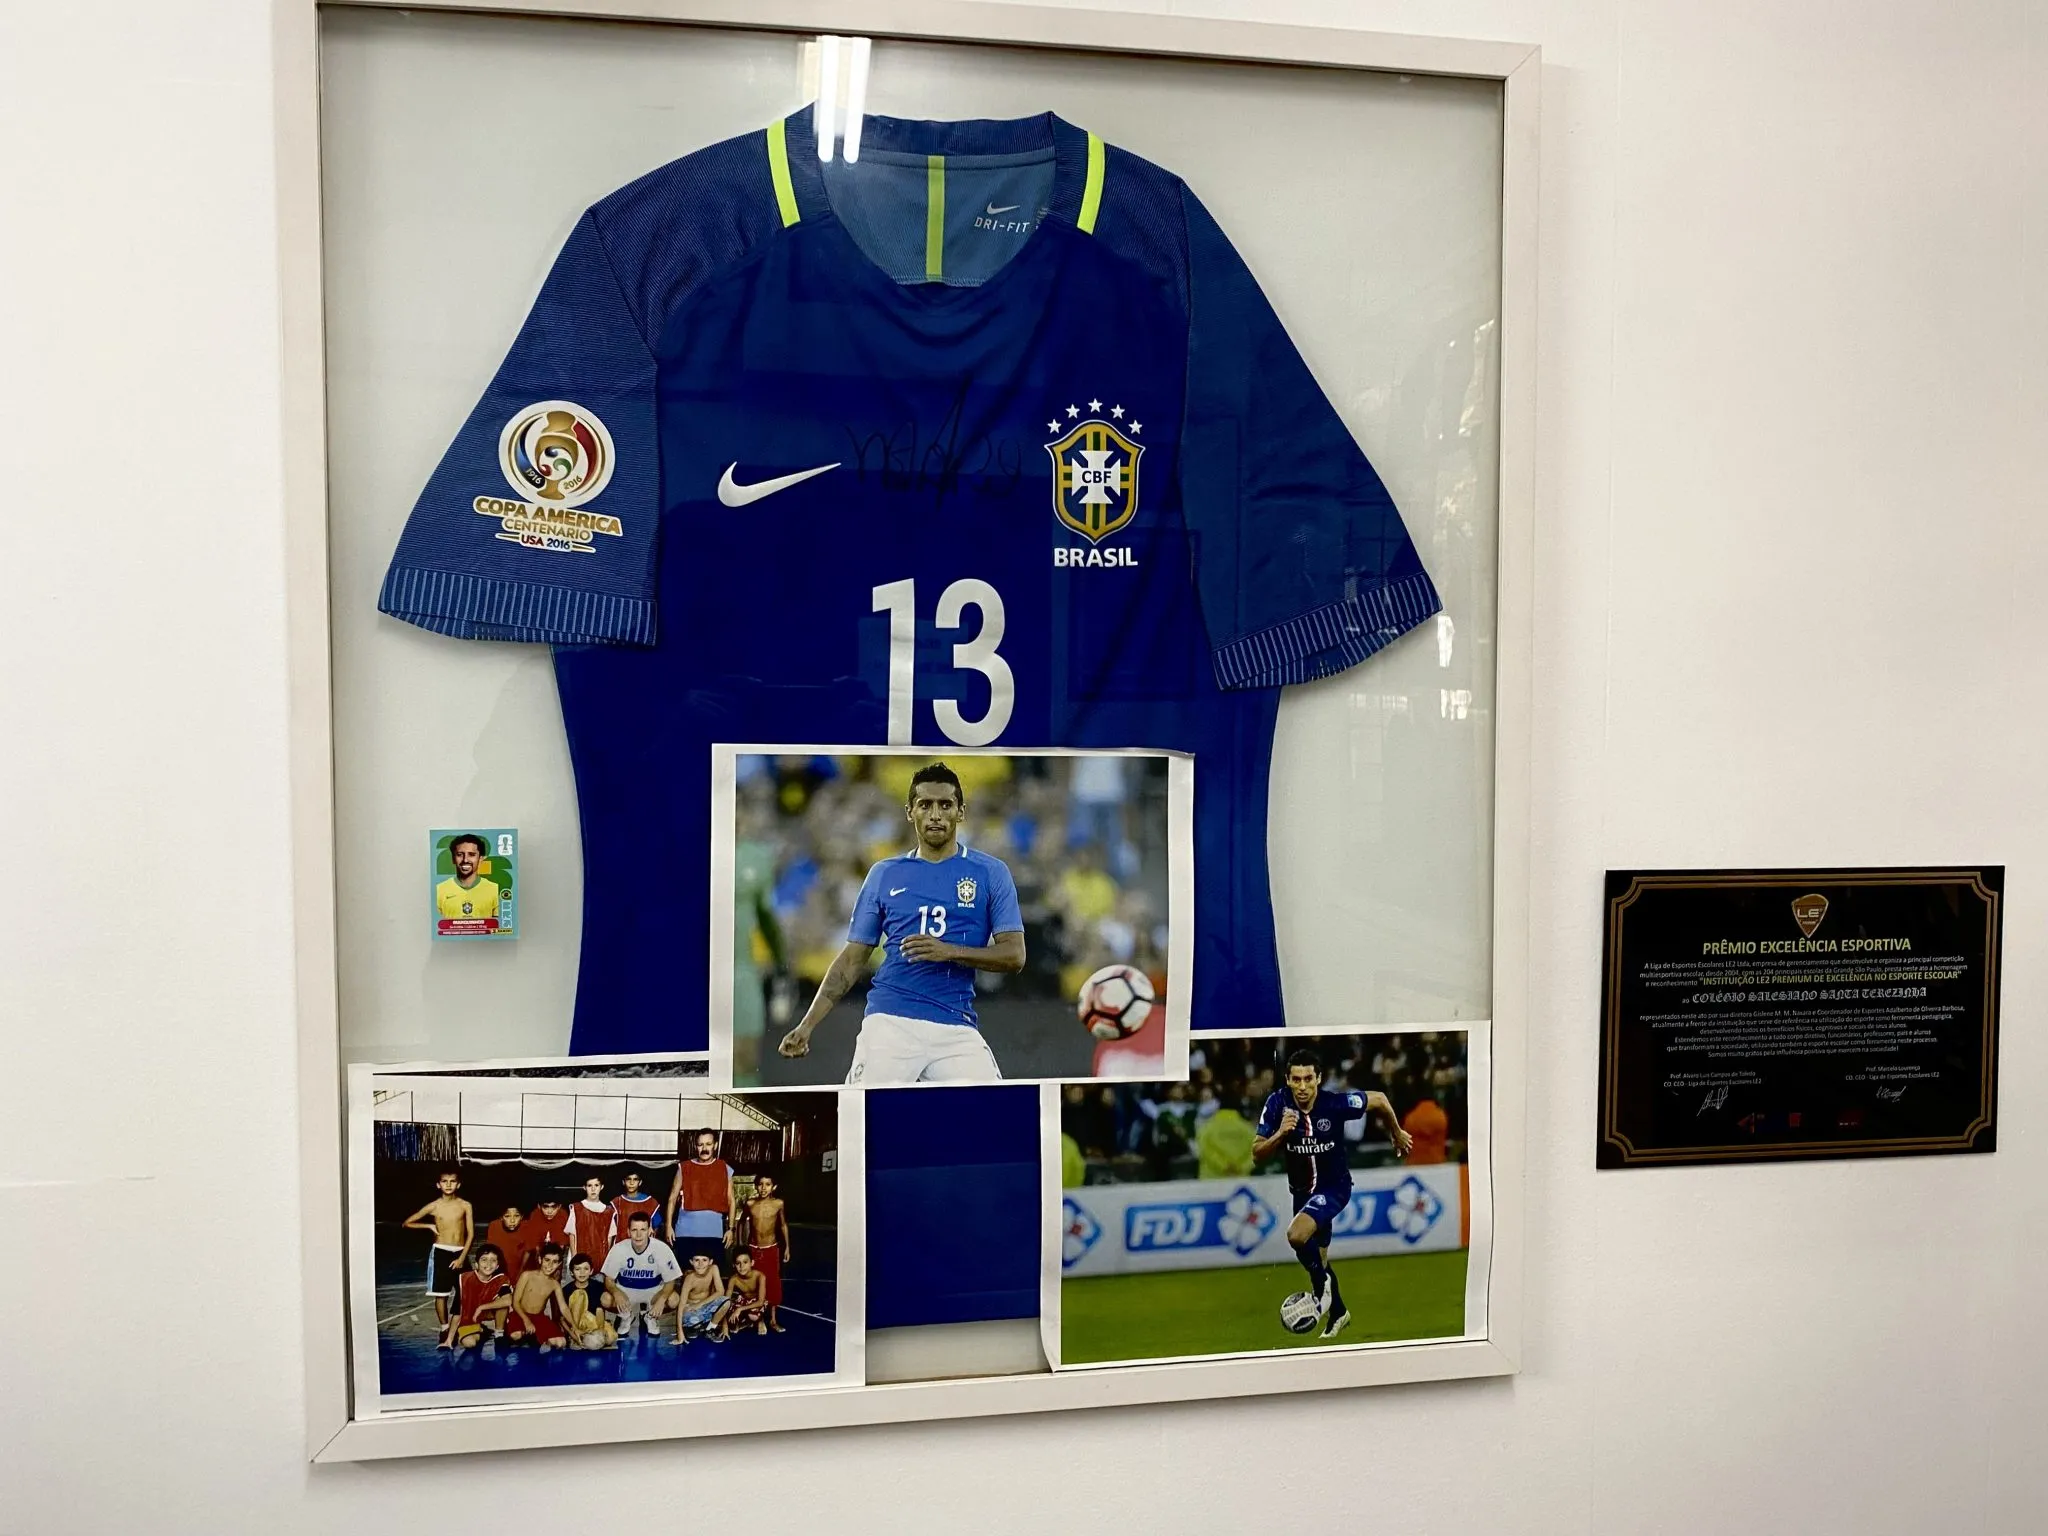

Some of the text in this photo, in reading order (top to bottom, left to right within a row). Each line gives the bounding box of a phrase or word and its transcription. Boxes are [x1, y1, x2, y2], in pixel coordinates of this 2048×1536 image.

[974, 217, 1030, 233] DRI-FIT
[525, 468, 542, 485] 1916
[563, 476, 582, 490] 2016
[1081, 470, 1111, 484] CBF
[475, 497, 621, 534] COPA AMERICA
[504, 518, 590, 541] CENTENARIO
[521, 534, 570, 550] USA 2016
[1053, 547, 1138, 567] BRASIL
[872, 578, 1015, 747] 13
[918, 905, 947, 938] 13
[1703, 938, 1912, 955] PRÊMIO EXCELÊNCIA ESPORTIVA
[1756, 976, 1770, 984] LE2
[1772, 975, 1812, 984] PREMIUM
[1813, 974, 1824, 982] DE
[1826, 973, 1873, 982] EXCELÊNCIA
[1874, 973, 1887, 981] NO
[1888, 972, 1923, 980] ESPORTE
[1692, 990, 1746, 1004] COLÉGIO
[1748, 990, 1818, 1002] SALESIANO
[1819, 988, 1859, 1000] SANTA
[1861, 987, 1927, 999] TEREZINHA
[1332, 1194, 1377, 1233] DJ
[1129, 1207, 1205, 1247] FDJ
